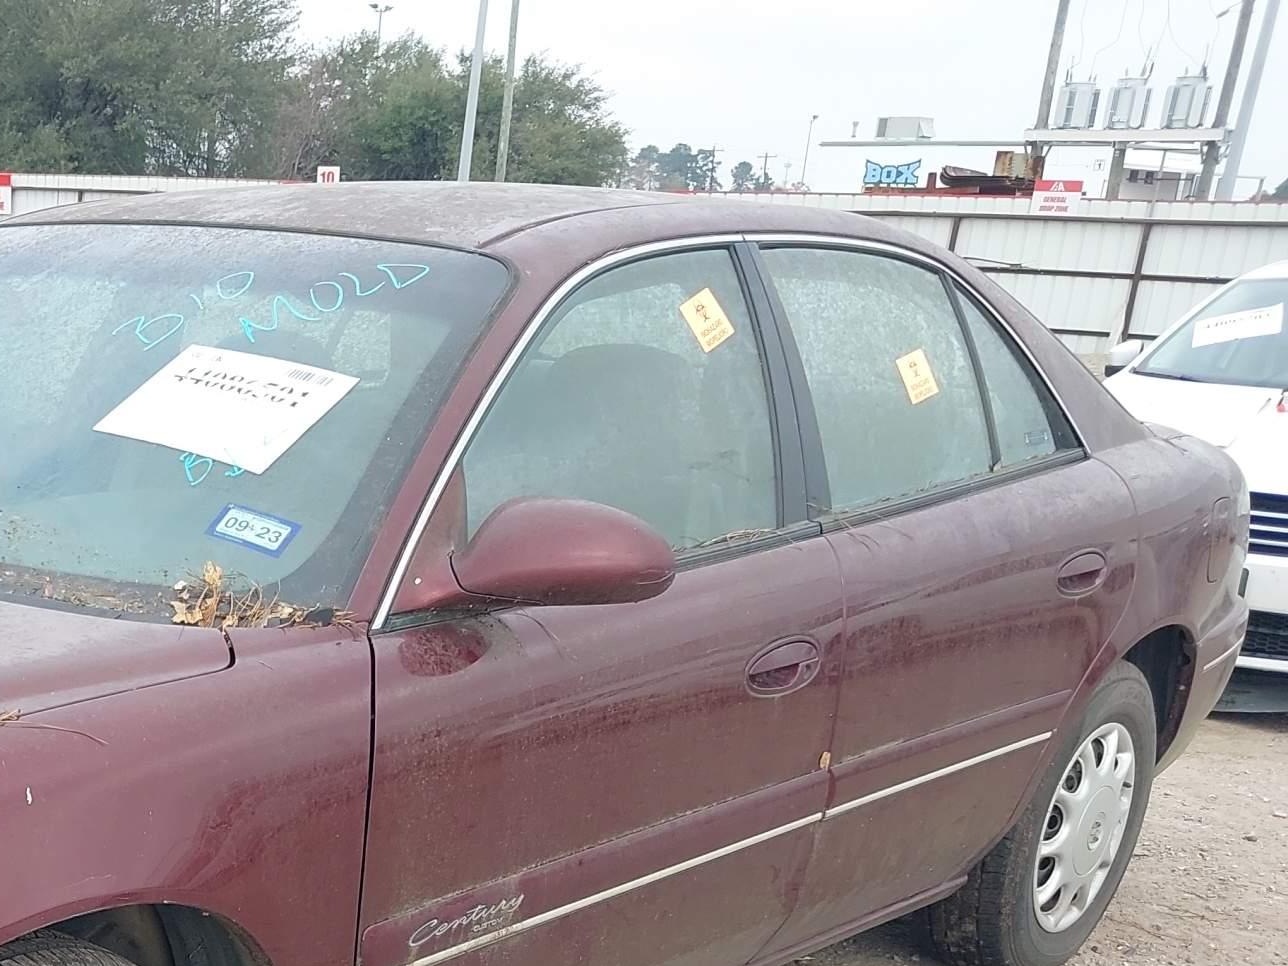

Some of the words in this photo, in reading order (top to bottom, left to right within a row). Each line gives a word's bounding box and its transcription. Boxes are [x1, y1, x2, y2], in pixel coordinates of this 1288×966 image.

[863, 158, 922, 185] BOX
[239, 264, 429, 342] MOLD
[224, 516, 250, 532] 09
[255, 526, 283, 544] 23
[408, 893, 525, 947] Century
